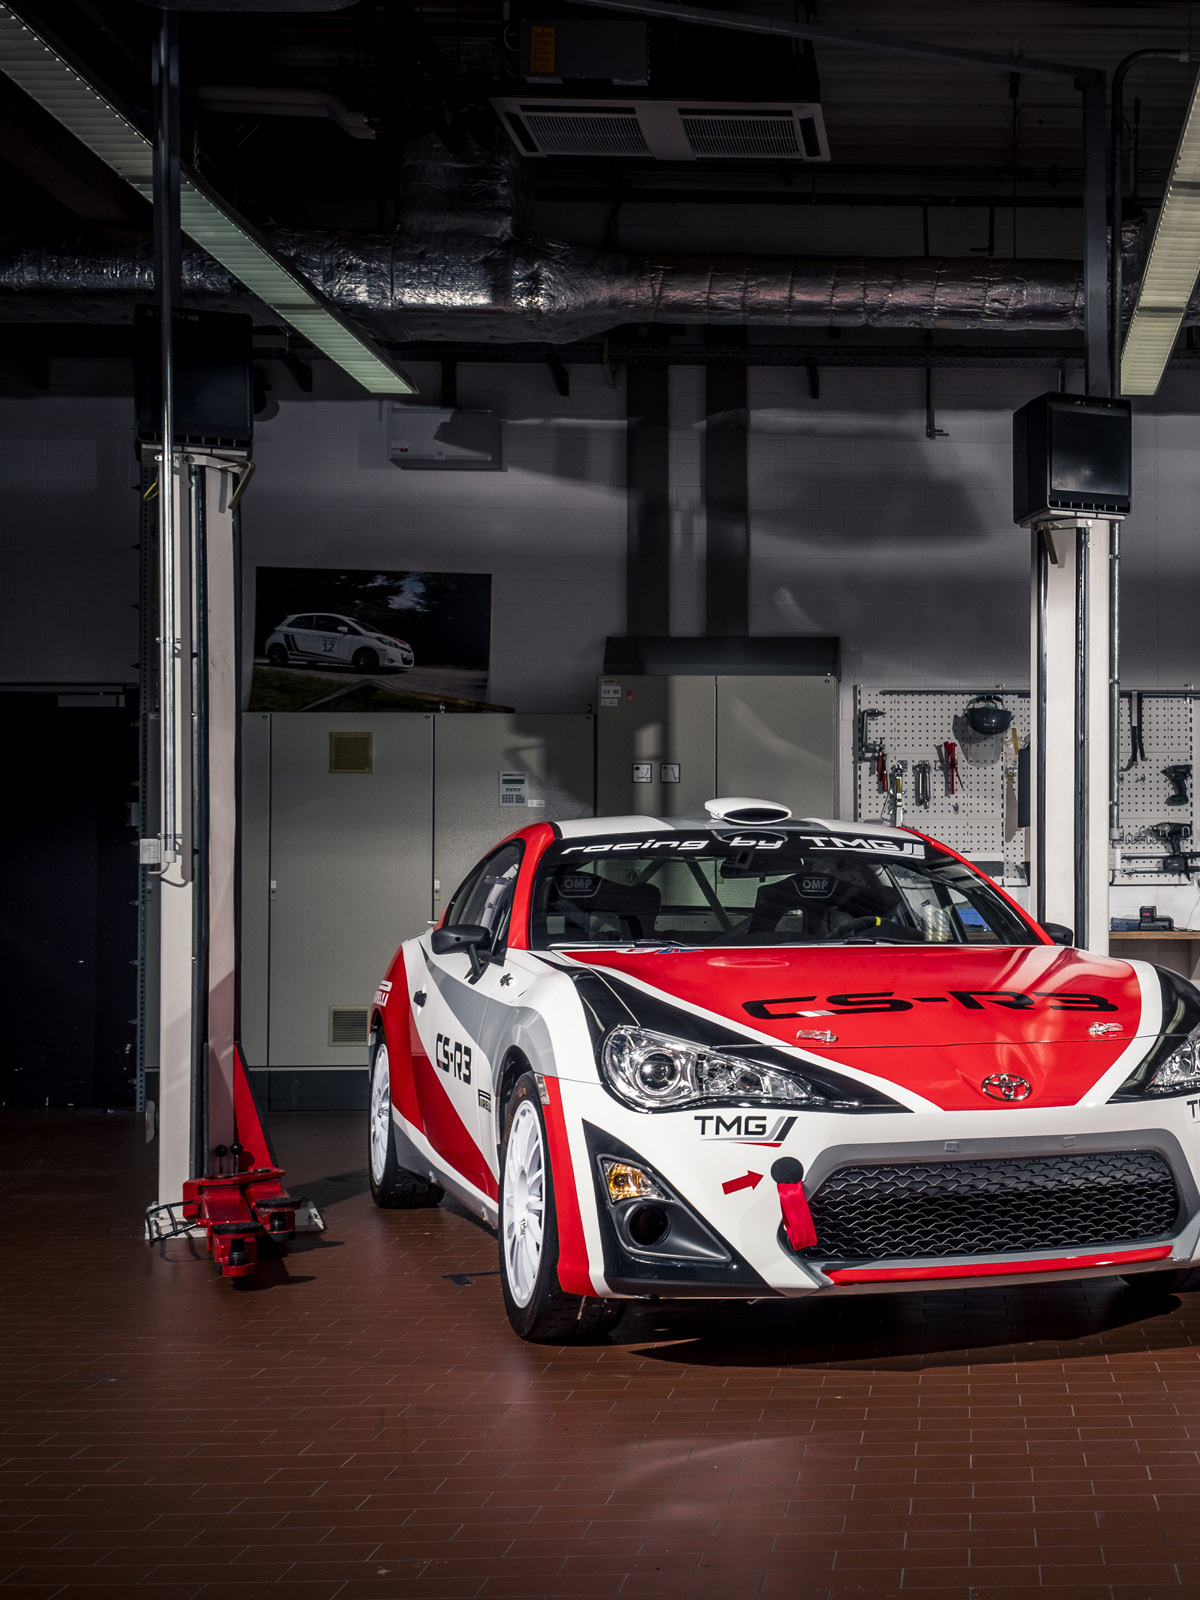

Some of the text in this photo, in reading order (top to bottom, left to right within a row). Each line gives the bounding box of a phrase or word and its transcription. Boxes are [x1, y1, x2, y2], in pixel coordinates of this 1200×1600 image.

[323, 642, 335, 652] 12
[560, 836, 901, 855] racing by TMG
[564, 878, 592, 889] OMP
[802, 879, 829, 890] OMP
[741, 990, 1120, 1020] CS-R3
[436, 1032, 472, 1086] CS-R3
[694, 1115, 767, 1135] TMG
